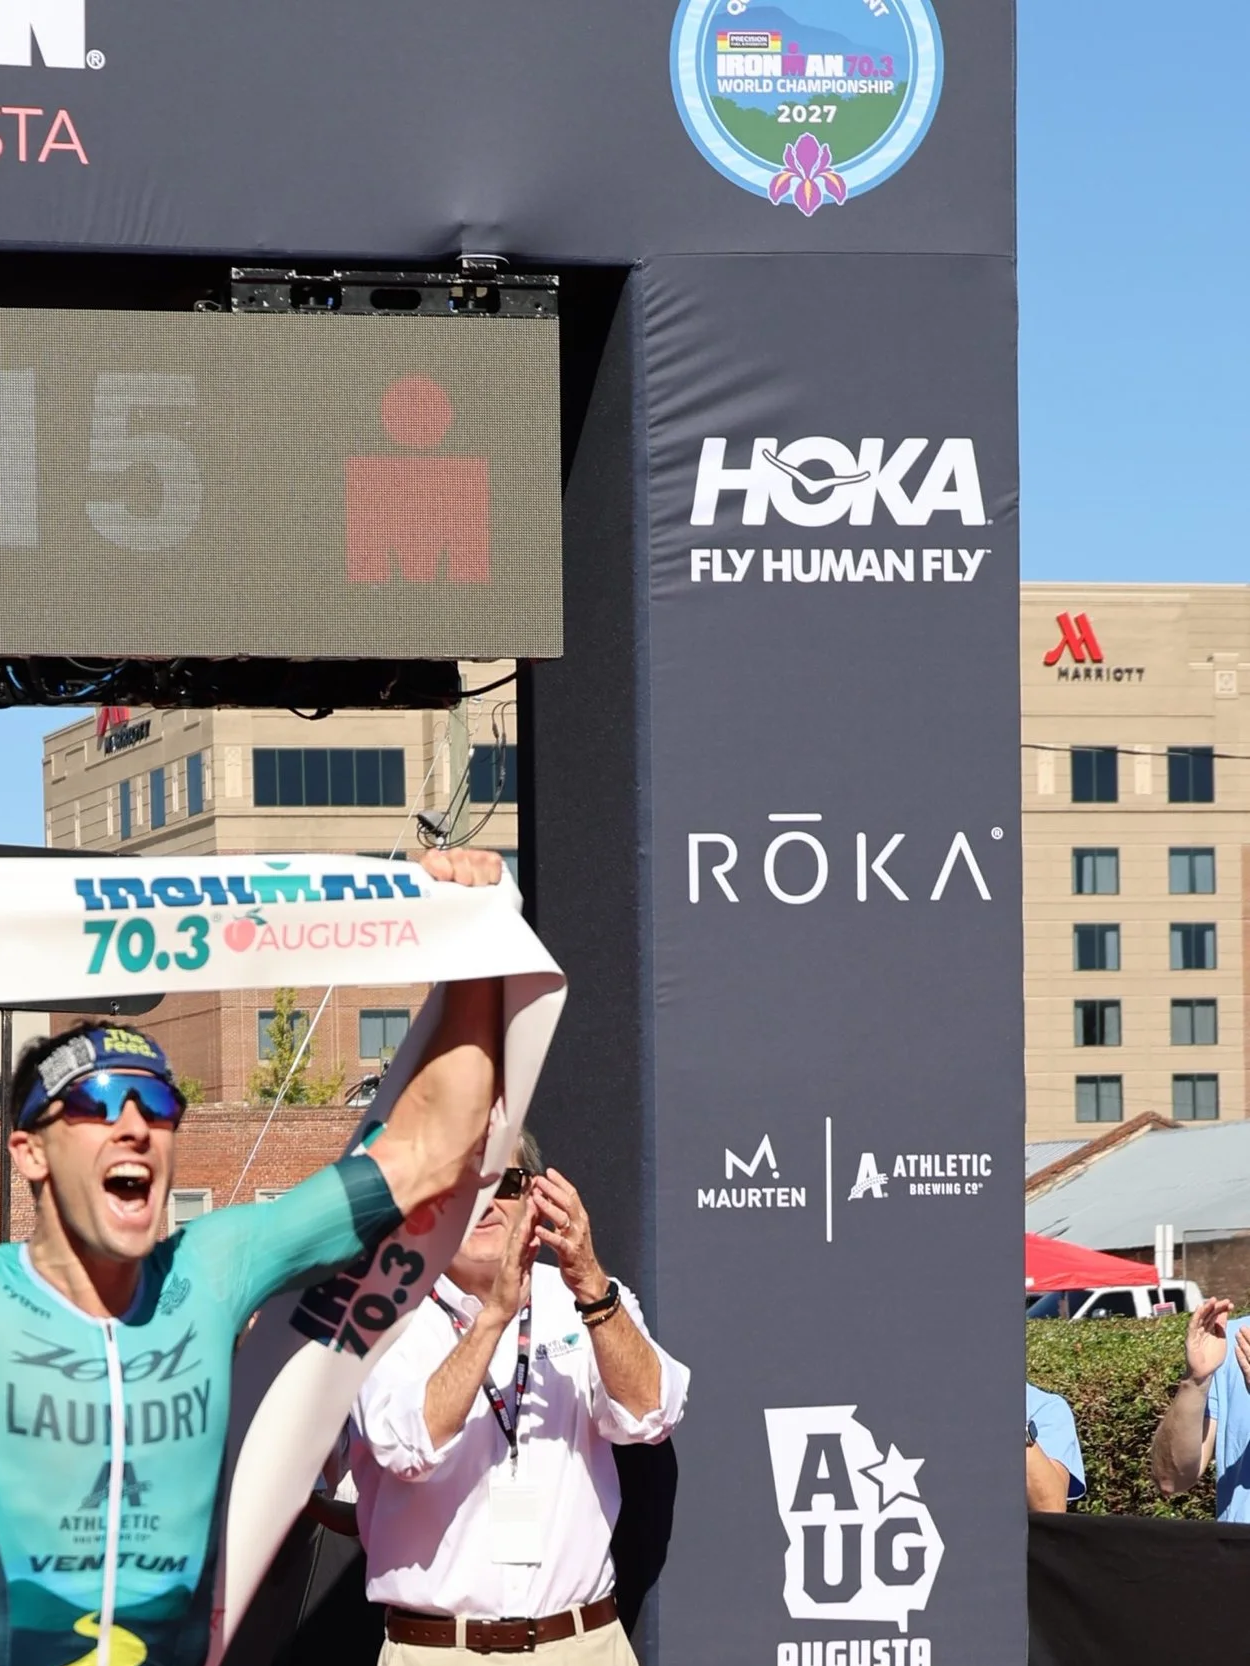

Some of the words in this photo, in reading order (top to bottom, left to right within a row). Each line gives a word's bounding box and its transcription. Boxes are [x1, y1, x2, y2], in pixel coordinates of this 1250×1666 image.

[717, 54, 843, 77] IRONMAN
[846, 55, 895, 78] 70.3
[717, 79, 773, 93] WORLD
[777, 79, 895, 94] CHAMPIONSHIP
[777, 104, 837, 123] 2027
[690, 436, 986, 527] HOKA
[690, 549, 755, 582] FLY
[763, 549, 914, 582] HUMAN
[922, 549, 986, 582] FLY
[1056, 667, 1145, 682] MARRIOTT
[83, 914, 211, 975] 70.3
[255, 919, 421, 951] AUGUSTA
[893, 1154, 992, 1178] ATHLETIC
[697, 1187, 807, 1209] MAURTEN
[909, 1182, 960, 1195] BREWING
[334, 1241, 425, 1361] 70.3
[5, 1378, 211, 1447] LAUNDRY
[29, 1551, 189, 1573] VENTUM
